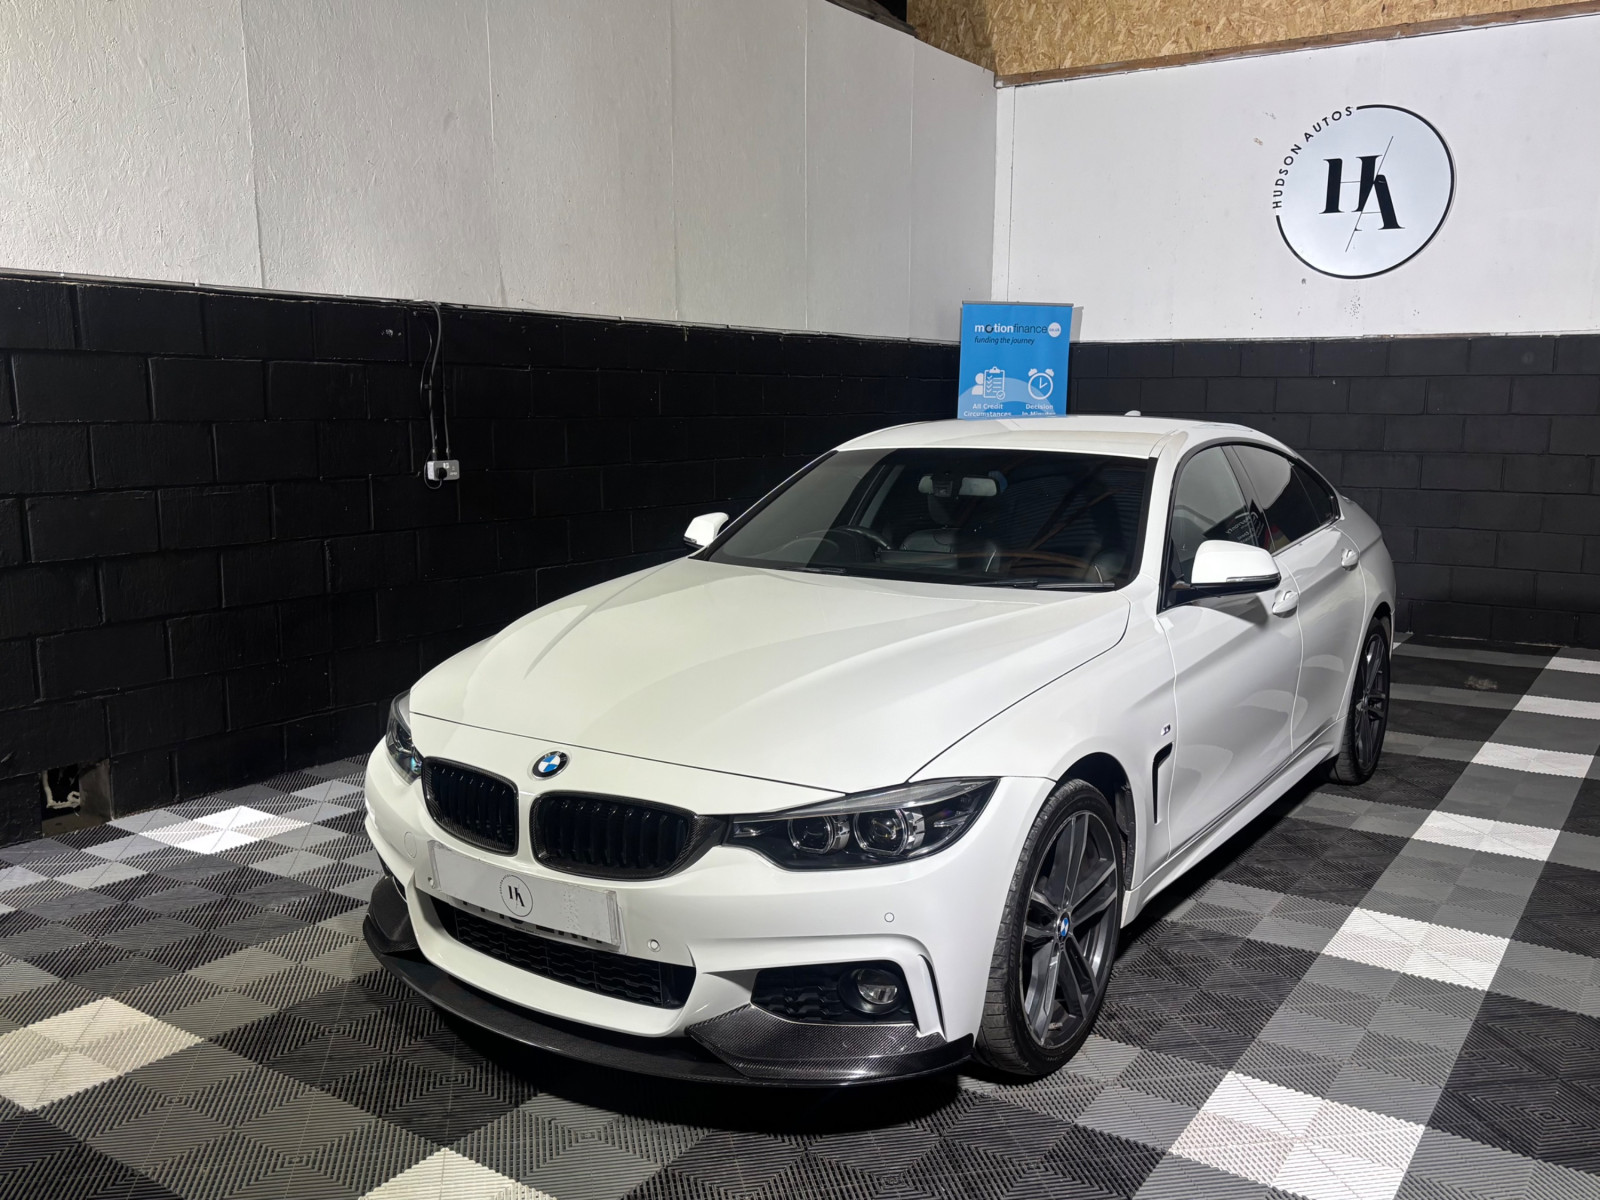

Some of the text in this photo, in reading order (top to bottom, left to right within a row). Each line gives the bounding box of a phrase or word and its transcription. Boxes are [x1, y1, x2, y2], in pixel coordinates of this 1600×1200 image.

[1272, 106, 1354, 209] HUDSON AUTOS
[974, 323, 1047, 334] motionfinance
[974, 336, 1035, 346] funding the journey
